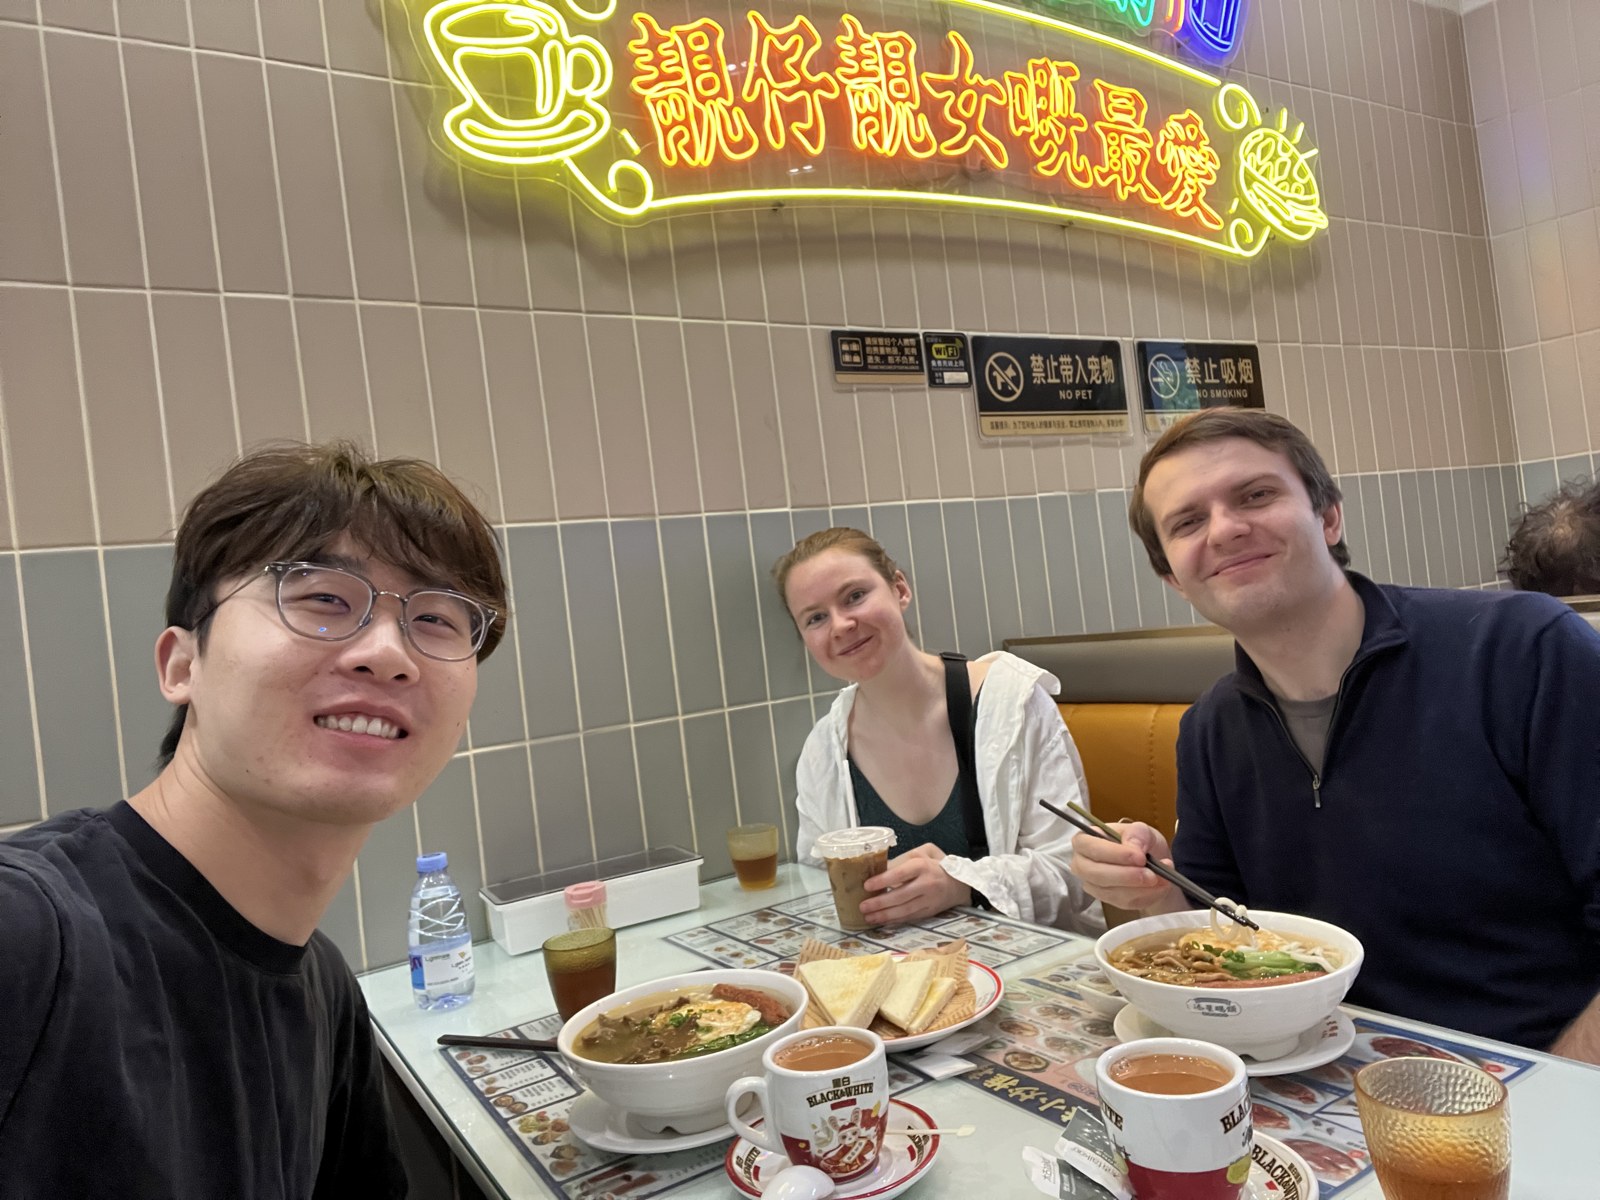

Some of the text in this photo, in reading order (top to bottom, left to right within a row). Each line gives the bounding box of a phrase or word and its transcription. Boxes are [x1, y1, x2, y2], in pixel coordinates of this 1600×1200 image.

[1029, 353, 1115, 385] 禁止带入宠物
[1184, 356, 1254, 385] 禁止吸烟
[1059, 389, 1093, 400] NO PET
[1196, 388, 1248, 399] NO SMOKING
[806, 1082, 874, 1108] BLACK&WHITE
